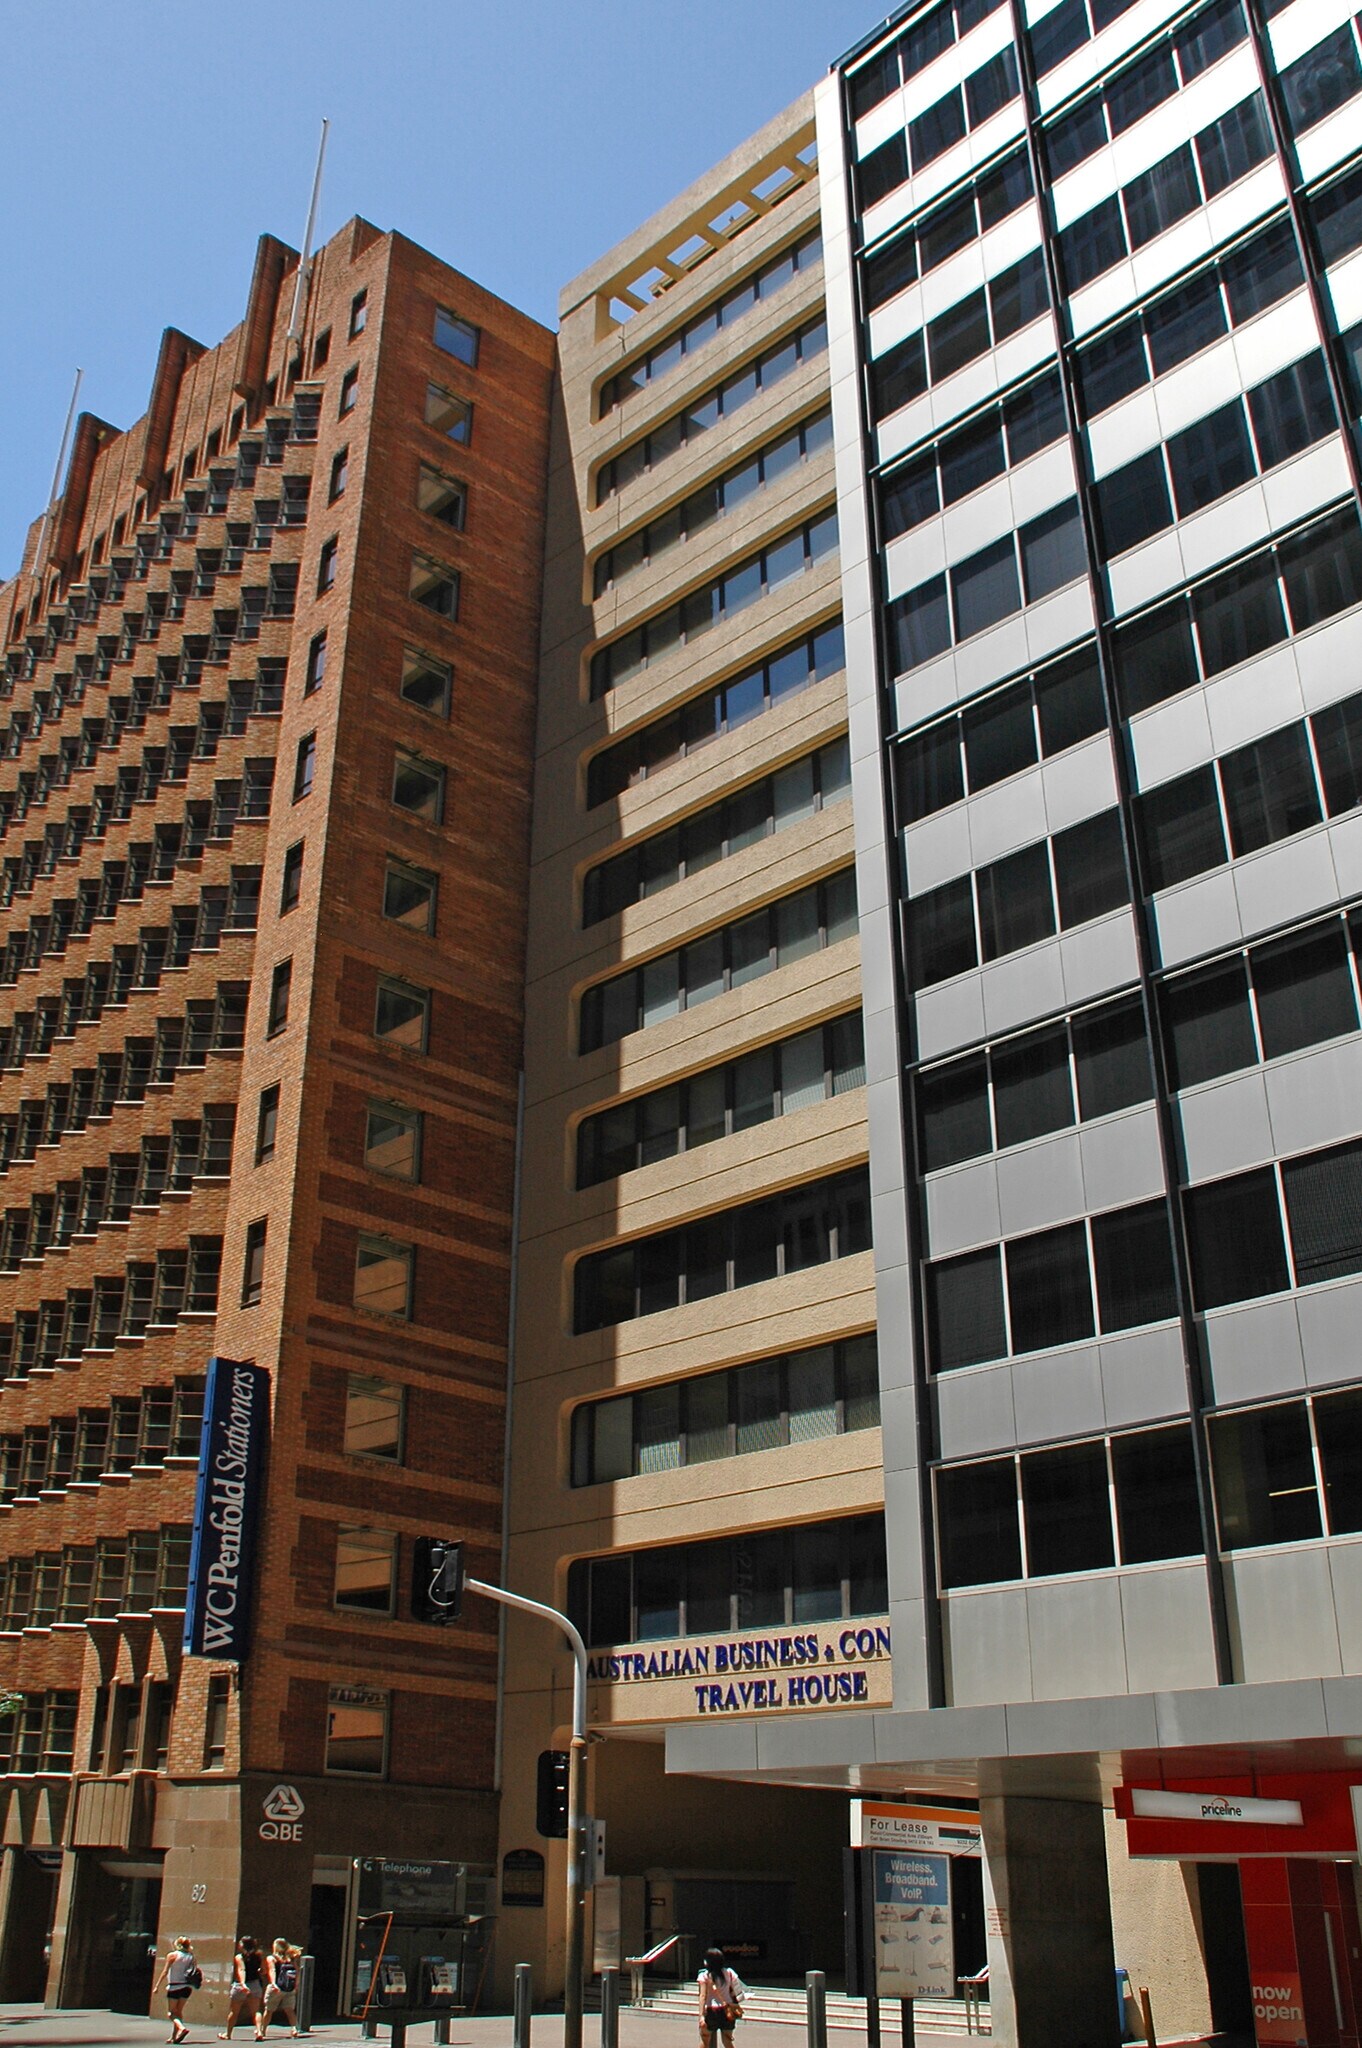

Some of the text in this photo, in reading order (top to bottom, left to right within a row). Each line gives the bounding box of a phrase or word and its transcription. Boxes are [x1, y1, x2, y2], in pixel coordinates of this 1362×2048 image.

[215, 1367, 255, 1479] Stationers
[208, 1477, 246, 1589] Penfold
[587, 1626, 891, 1680] AUSTRALIAN BUSINESS & CON
[695, 1671, 868, 1712] TRAVEL HOUSE
[1201, 1802, 1242, 1817] priceline
[259, 1822, 304, 1841] QBE
[870, 1818, 928, 1833] For Lease
[379, 1861, 432, 1874] Telephone
[890, 1859, 933, 1873] Wireless.
[885, 1872, 938, 1886] Broadband.
[191, 1884, 207, 1903] 82
[918, 1985, 946, 1994] D-Link
[1252, 1986, 1291, 2000] now
[1254, 2005, 1302, 2023] open
